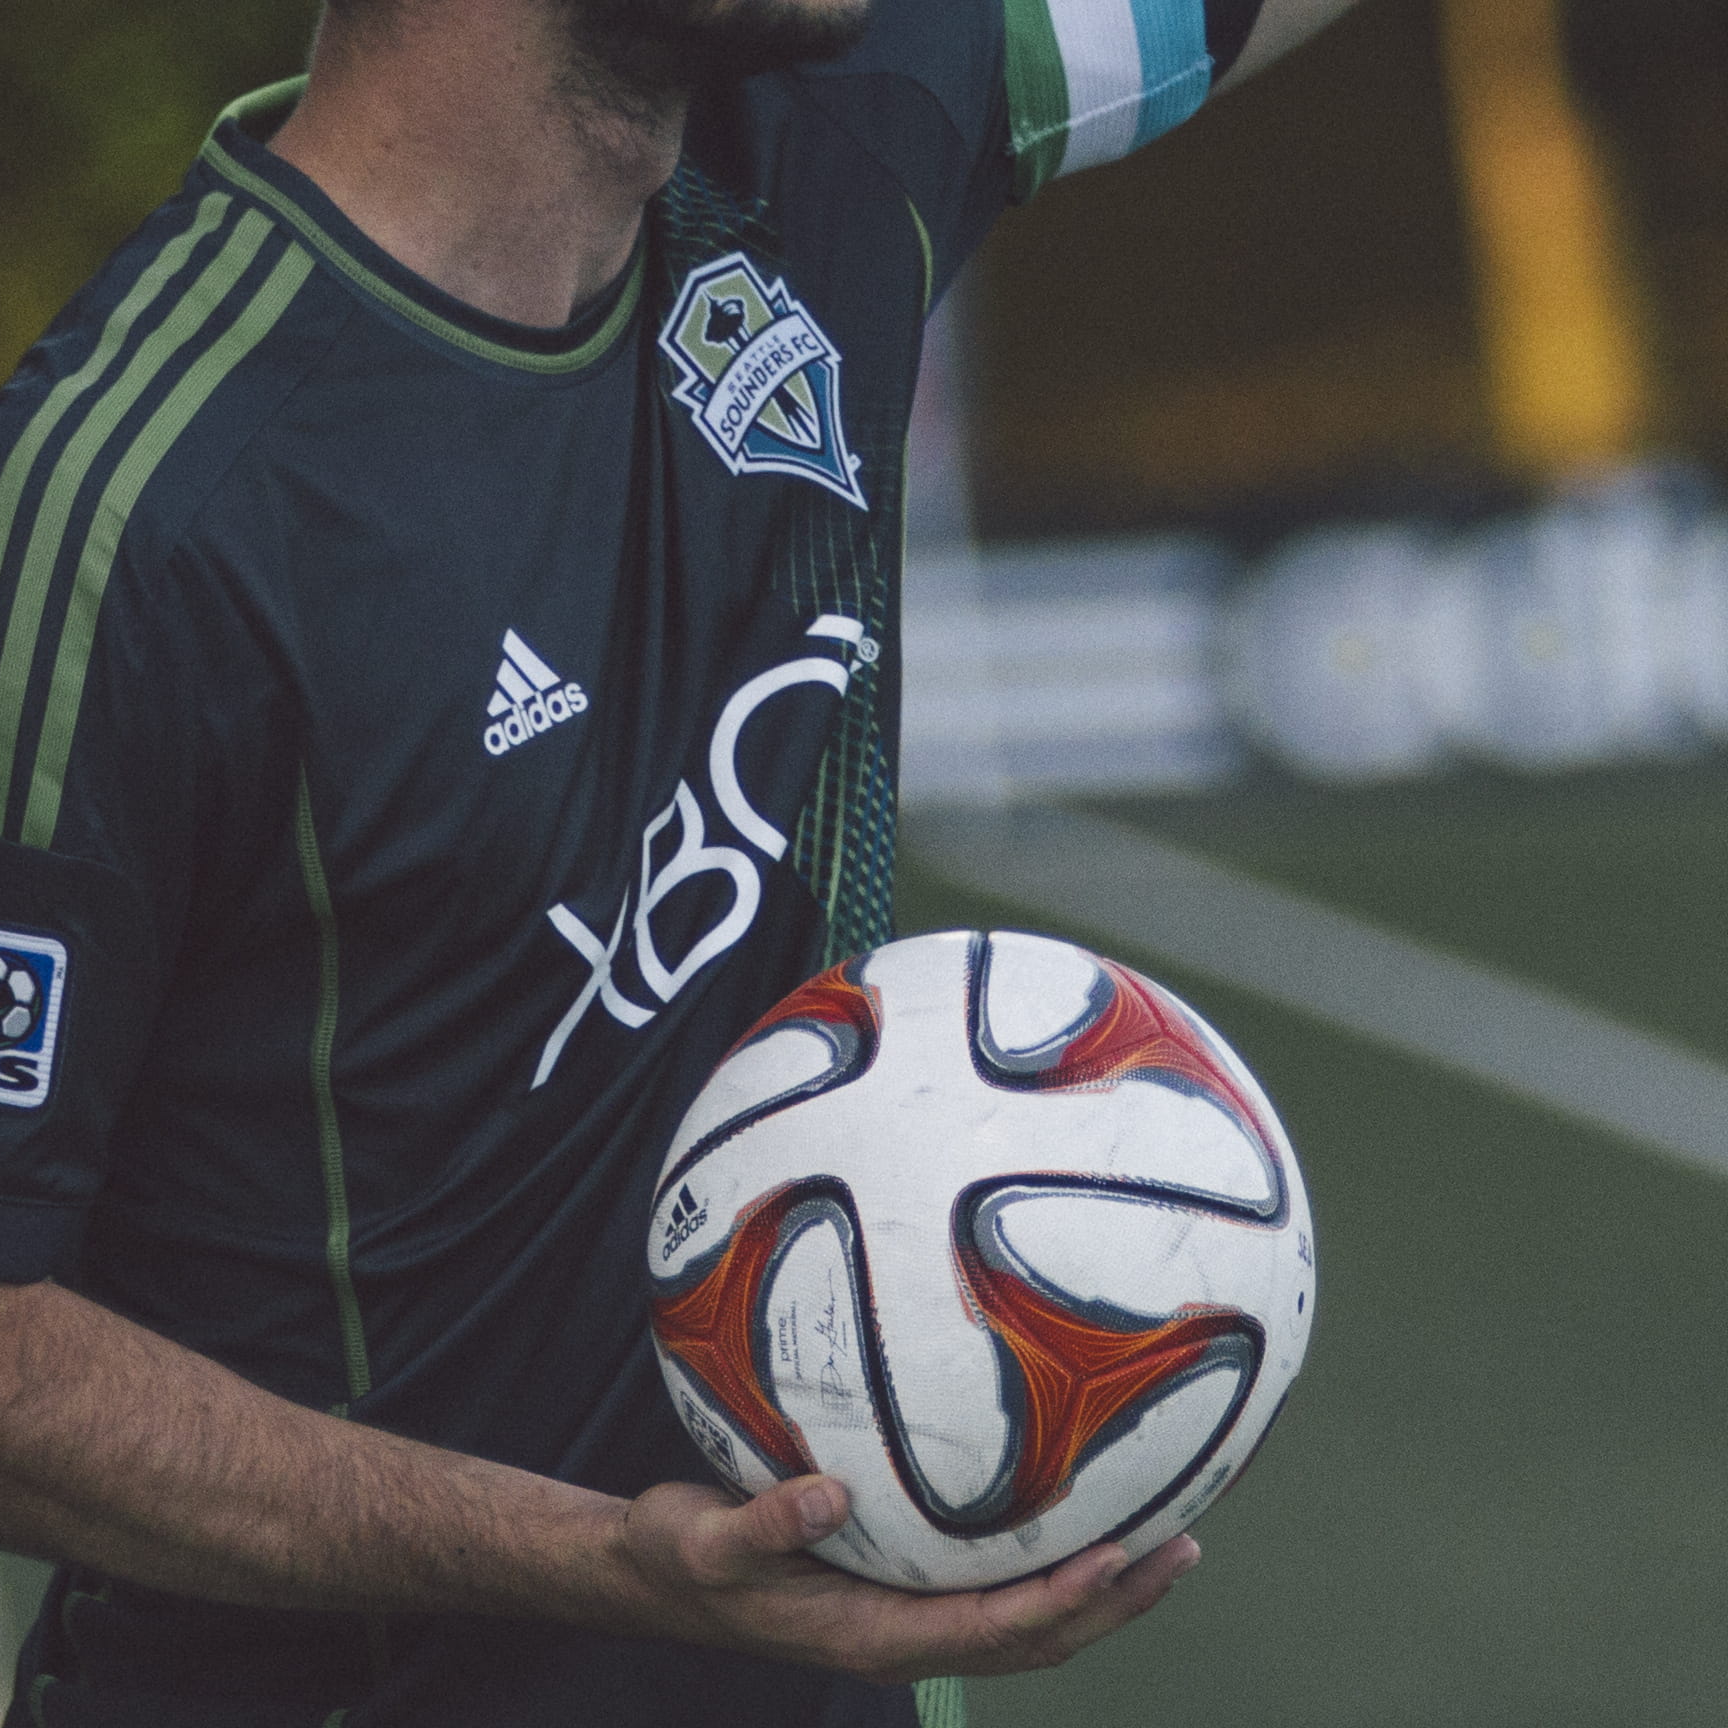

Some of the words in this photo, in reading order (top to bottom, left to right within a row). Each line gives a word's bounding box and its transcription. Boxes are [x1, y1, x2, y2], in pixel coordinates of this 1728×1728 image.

[720, 343, 795, 442] SOUNDERS
[791, 333, 819, 355] FC
[727, 335, 780, 393] SEATTLE
[483, 681, 589, 757] adidas
[663, 1208, 707, 1262] adidas
[777, 1317, 792, 1362] prime
